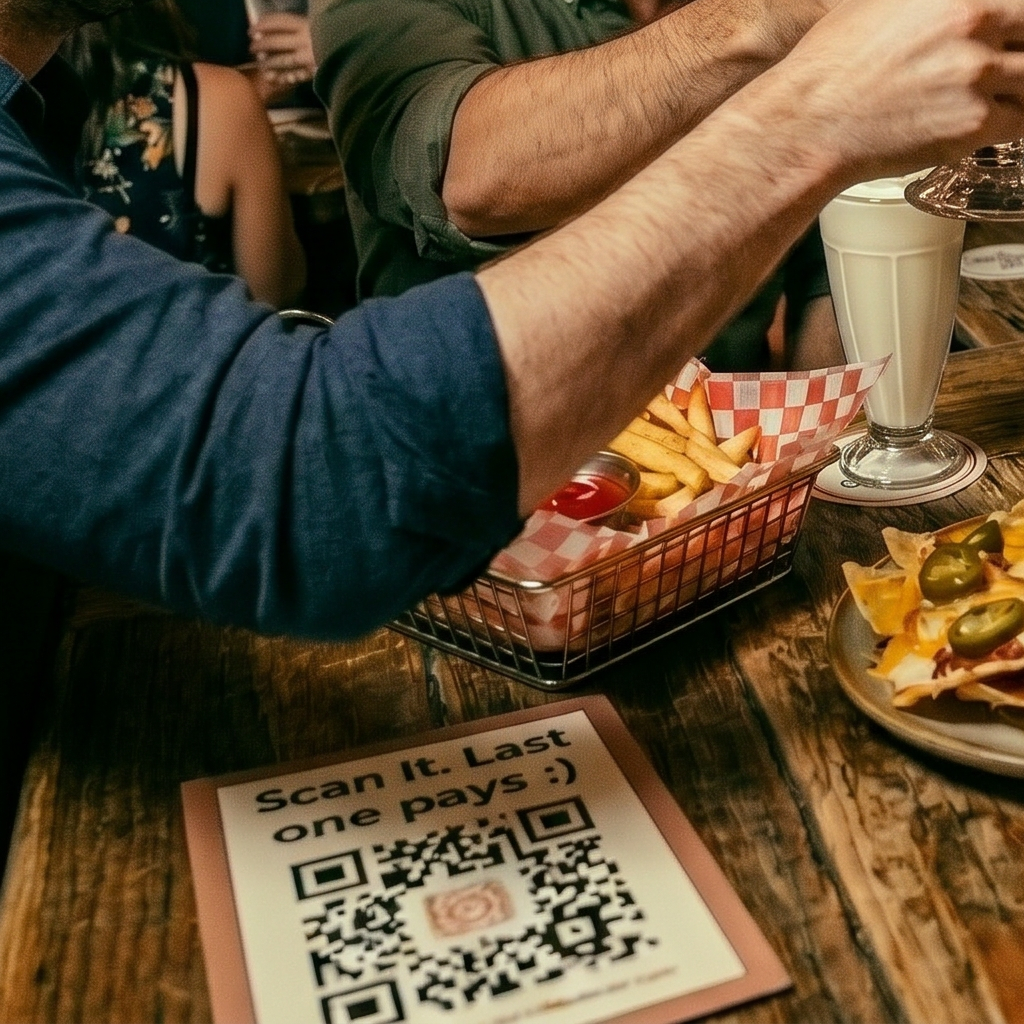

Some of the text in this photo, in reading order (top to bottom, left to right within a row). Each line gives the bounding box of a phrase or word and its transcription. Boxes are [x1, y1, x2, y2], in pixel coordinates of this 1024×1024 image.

[255, 728, 573, 813] Scan It. Last
[273, 808, 382, 843] one
[400, 772, 529, 824] pays
